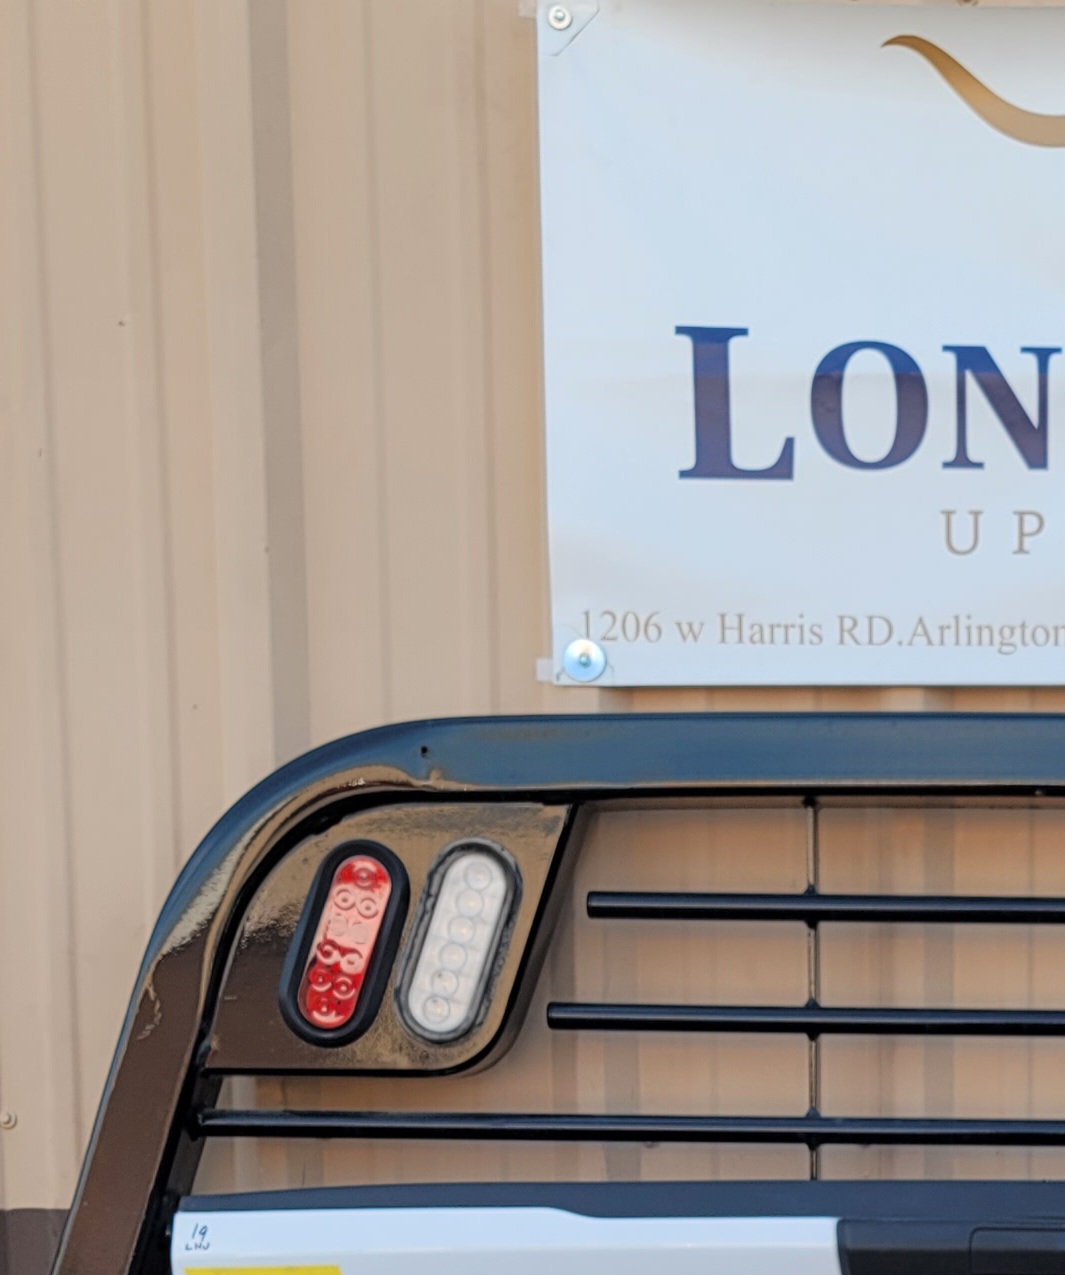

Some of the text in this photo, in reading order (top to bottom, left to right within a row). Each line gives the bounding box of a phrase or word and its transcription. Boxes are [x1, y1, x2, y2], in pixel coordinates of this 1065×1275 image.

[580, 610, 663, 643] 1206
[675, 621, 705, 643] w
[718, 613, 824, 645] Harris
